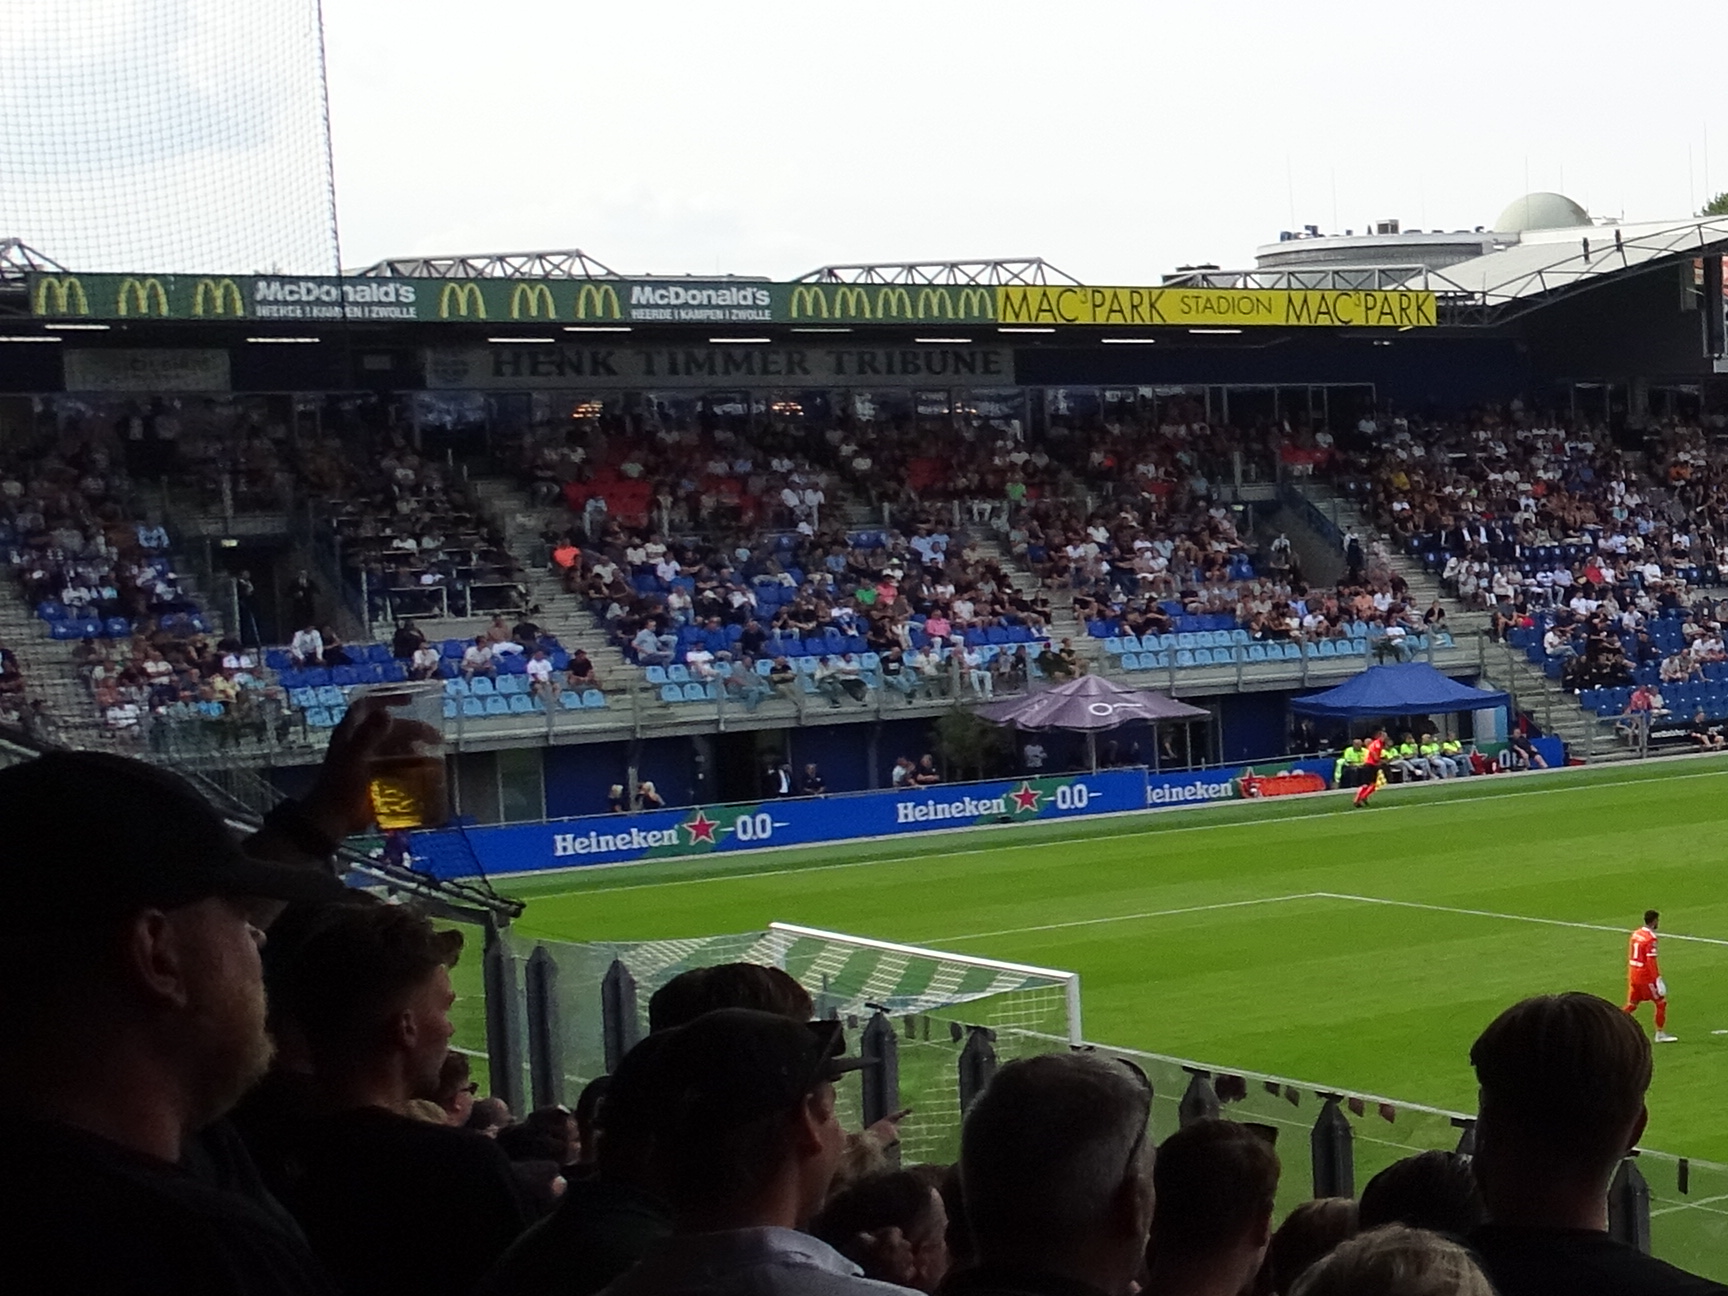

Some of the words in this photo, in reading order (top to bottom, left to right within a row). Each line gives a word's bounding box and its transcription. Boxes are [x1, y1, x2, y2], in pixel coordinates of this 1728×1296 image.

[256, 281, 416, 303] McDonald's
[632, 286, 770, 305] McDonald's
[731, 309, 771, 320] ZWOLLE
[1181, 296, 1272, 315] STADION
[491, 350, 619, 377] HENK
[637, 350, 811, 377] TIMMER
[835, 350, 1002, 376] TRIBUNE
[897, 797, 1006, 823] Heineken
[554, 830, 680, 856] Heineken
[1632, 942, 1639, 959] 1
